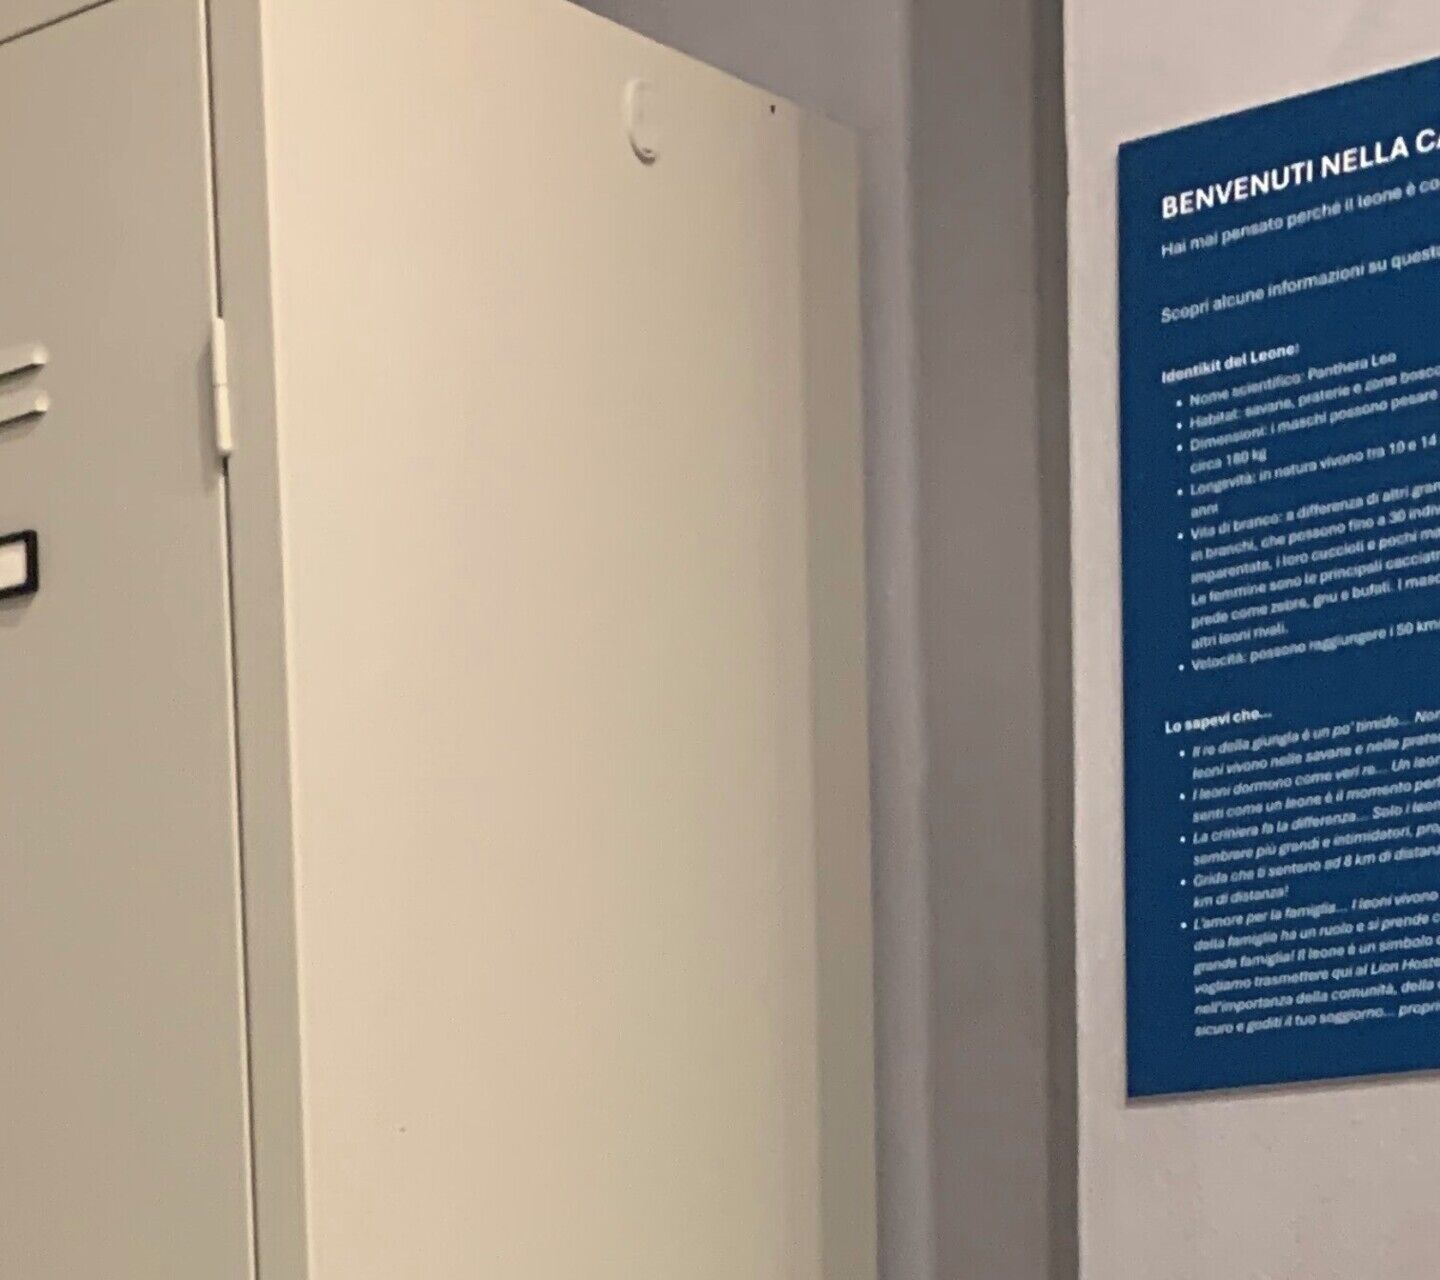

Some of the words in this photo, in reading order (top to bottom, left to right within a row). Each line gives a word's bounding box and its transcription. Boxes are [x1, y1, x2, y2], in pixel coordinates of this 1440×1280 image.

[1161, 160, 1313, 220] BENVENUTI
[1320, 137, 1409, 179] NELLA
[1414, 129, 1440, 154] C
[1161, 239, 1186, 258] Hai
[1189, 231, 1218, 250] mai
[1221, 216, 1284, 246] pensato
[1356, 186, 1403, 208] leone
[1161, 298, 1209, 323] Scopri
[1212, 288, 1265, 311] alcune
[1267, 263, 1365, 297] informazioni
[1161, 359, 1221, 384] Identikit
[1223, 352, 1248, 370] del
[1189, 388, 1229, 406] Nome
[1307, 358, 1368, 381] Panthera
[1370, 352, 1397, 367] Leo
[1277, 411, 1327, 433] maschi
[1329, 399, 1388, 424] possono
[1390, 388, 1438, 411] pesare
[1319, 450, 1364, 469] vivono
[1287, 522, 1346, 546] possono
[1378, 529, 1418, 551] pochi
[1319, 559, 1383, 585] principali
[1230, 604, 1268, 620] come
[1249, 642, 1307, 664] possono
[1184, 711, 1231, 731] sapevi
[1226, 758, 1268, 774] vivono
[1294, 771, 1333, 786] come
[1225, 803, 1263, 818] come
[1284, 794, 1322, 809] leone
[1345, 781, 1412, 800] momento
[1393, 890, 1439, 906] vivono
[1307, 946, 1345, 959] leone
